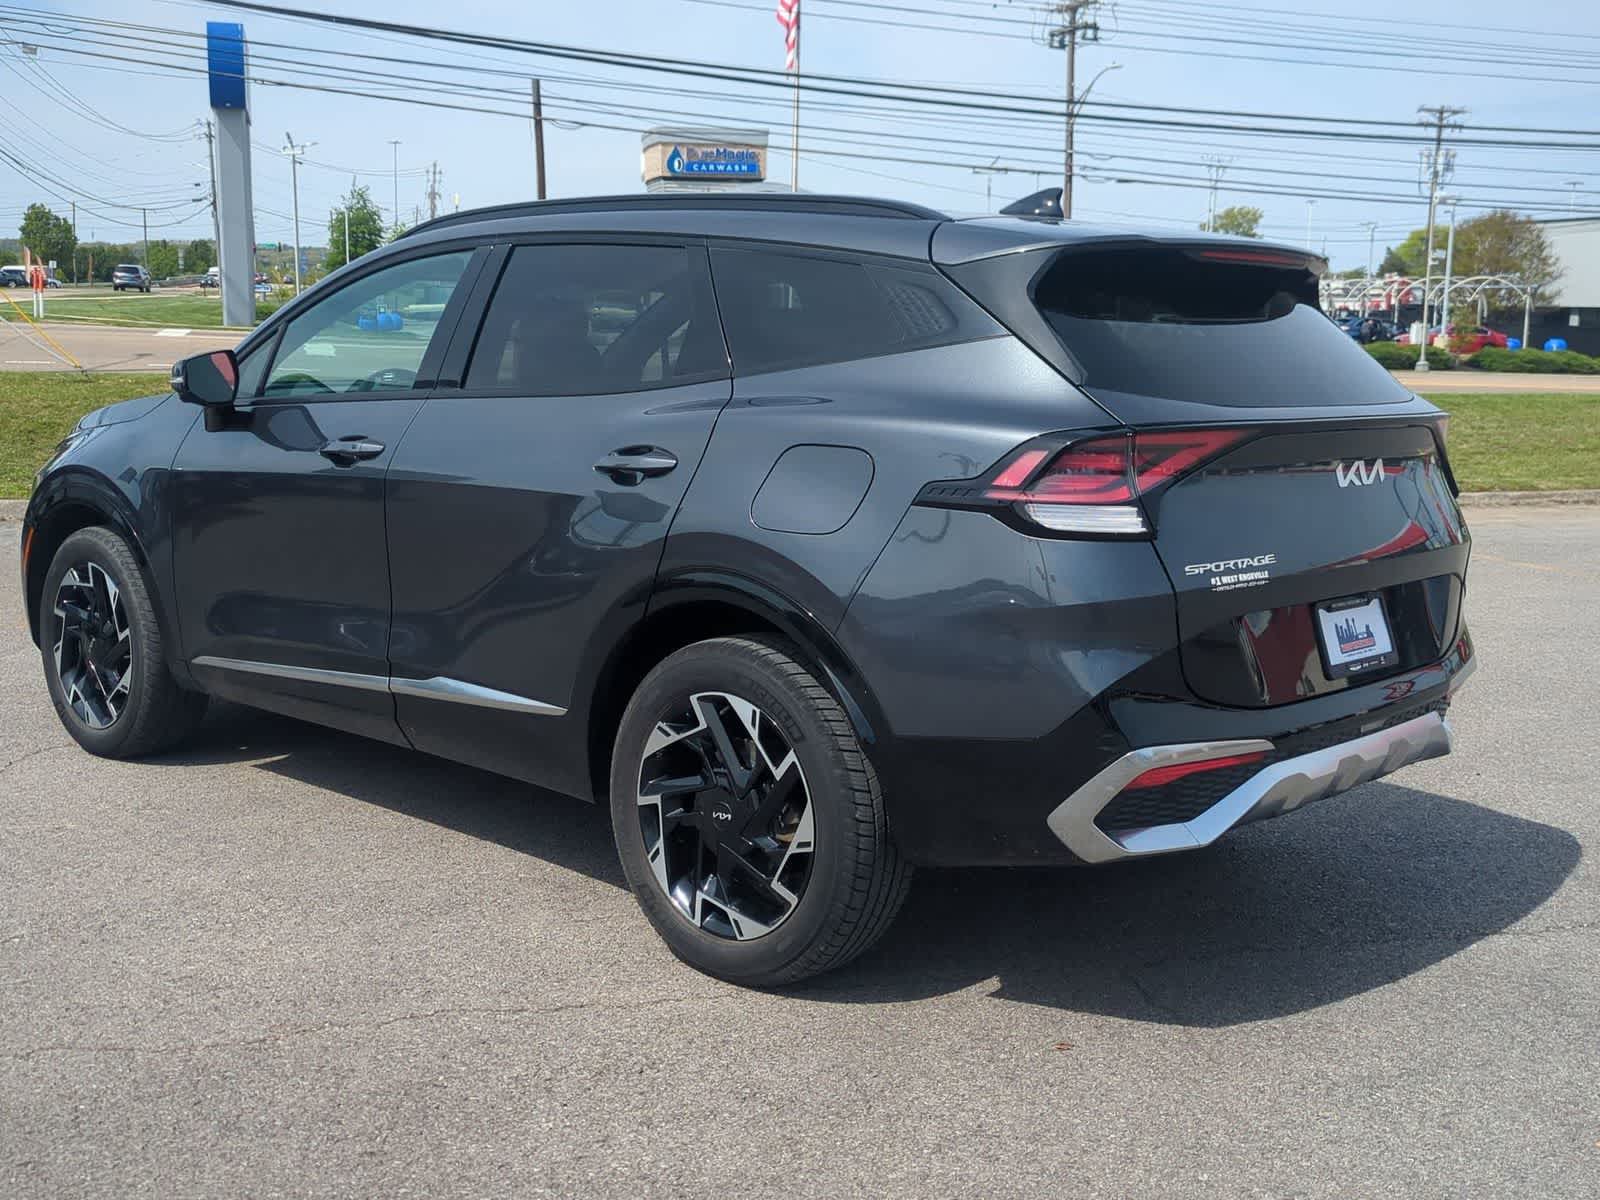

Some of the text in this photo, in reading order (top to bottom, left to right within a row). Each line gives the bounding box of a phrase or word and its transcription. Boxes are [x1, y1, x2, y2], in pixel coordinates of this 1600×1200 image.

[692, 163, 748, 172] CARWASH
[1335, 458, 1385, 488] KIA
[1184, 553, 1277, 576] SPORTAGE
